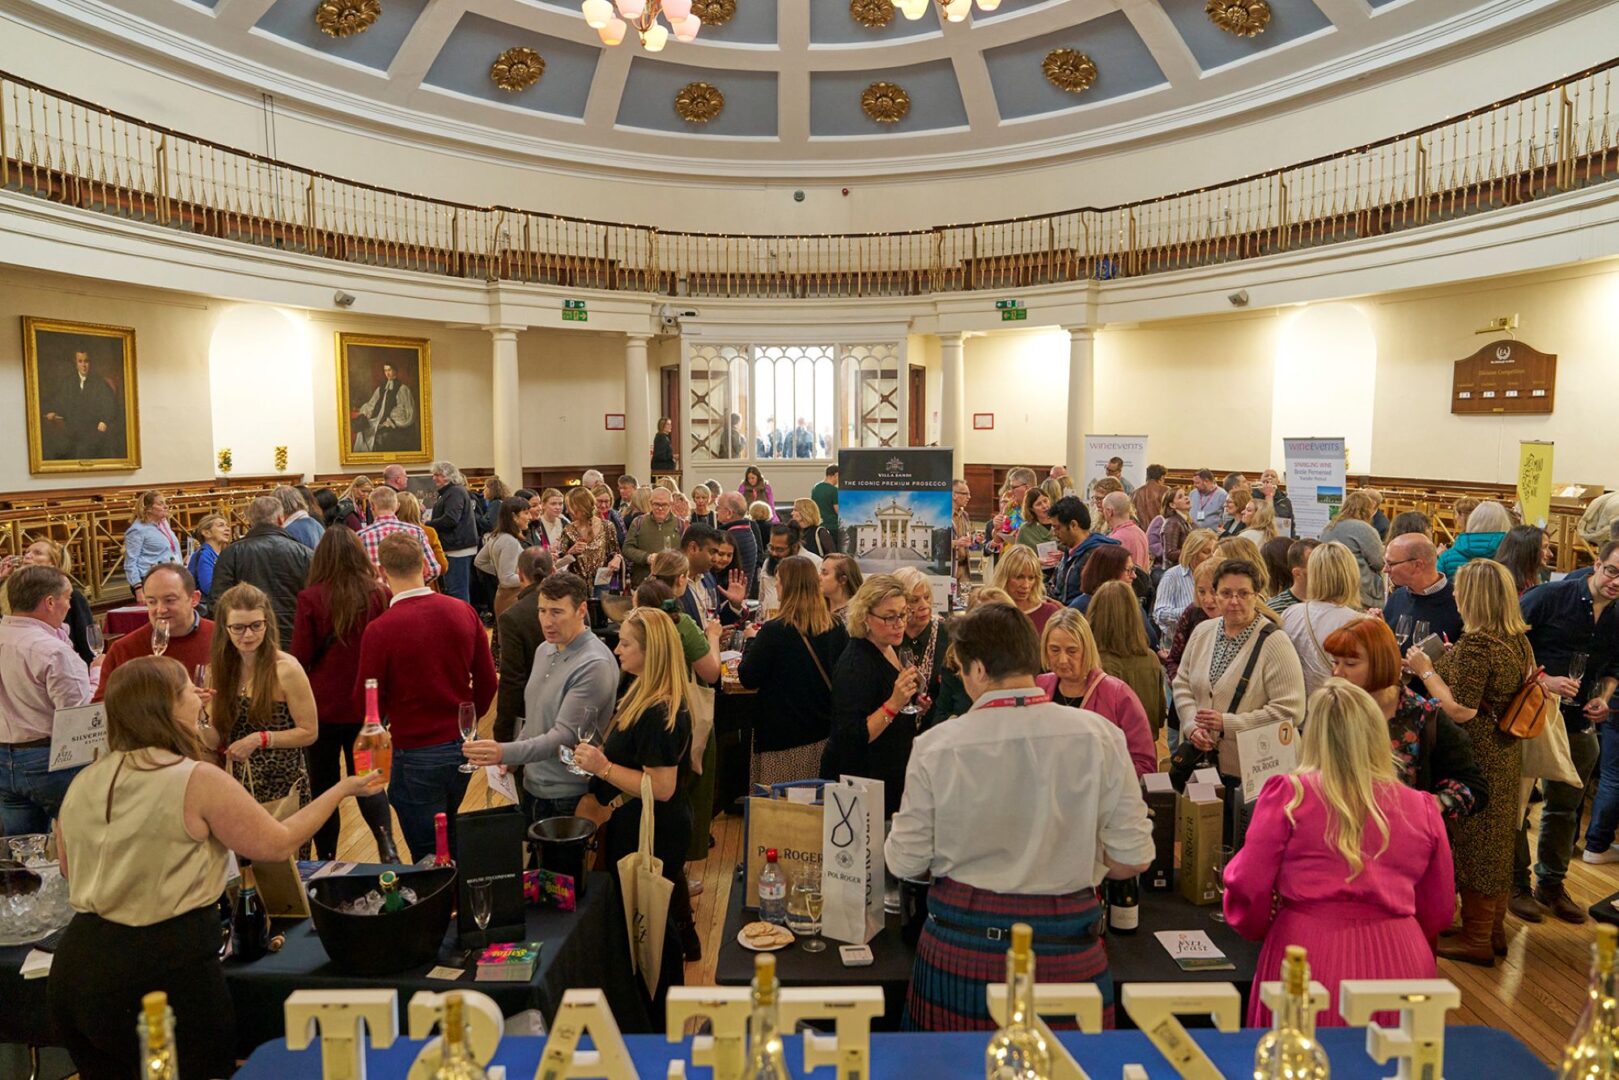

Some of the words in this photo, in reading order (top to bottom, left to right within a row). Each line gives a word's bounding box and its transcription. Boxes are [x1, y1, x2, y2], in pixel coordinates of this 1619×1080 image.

[1282, 728, 1289, 740] 7
[1252, 765, 1261, 774] POL
[1262, 759, 1280, 770] ROGER
[1185, 816, 1193, 858] ROGER
[827, 871, 840, 881] POL
[839, 871, 861, 884] ROGER
